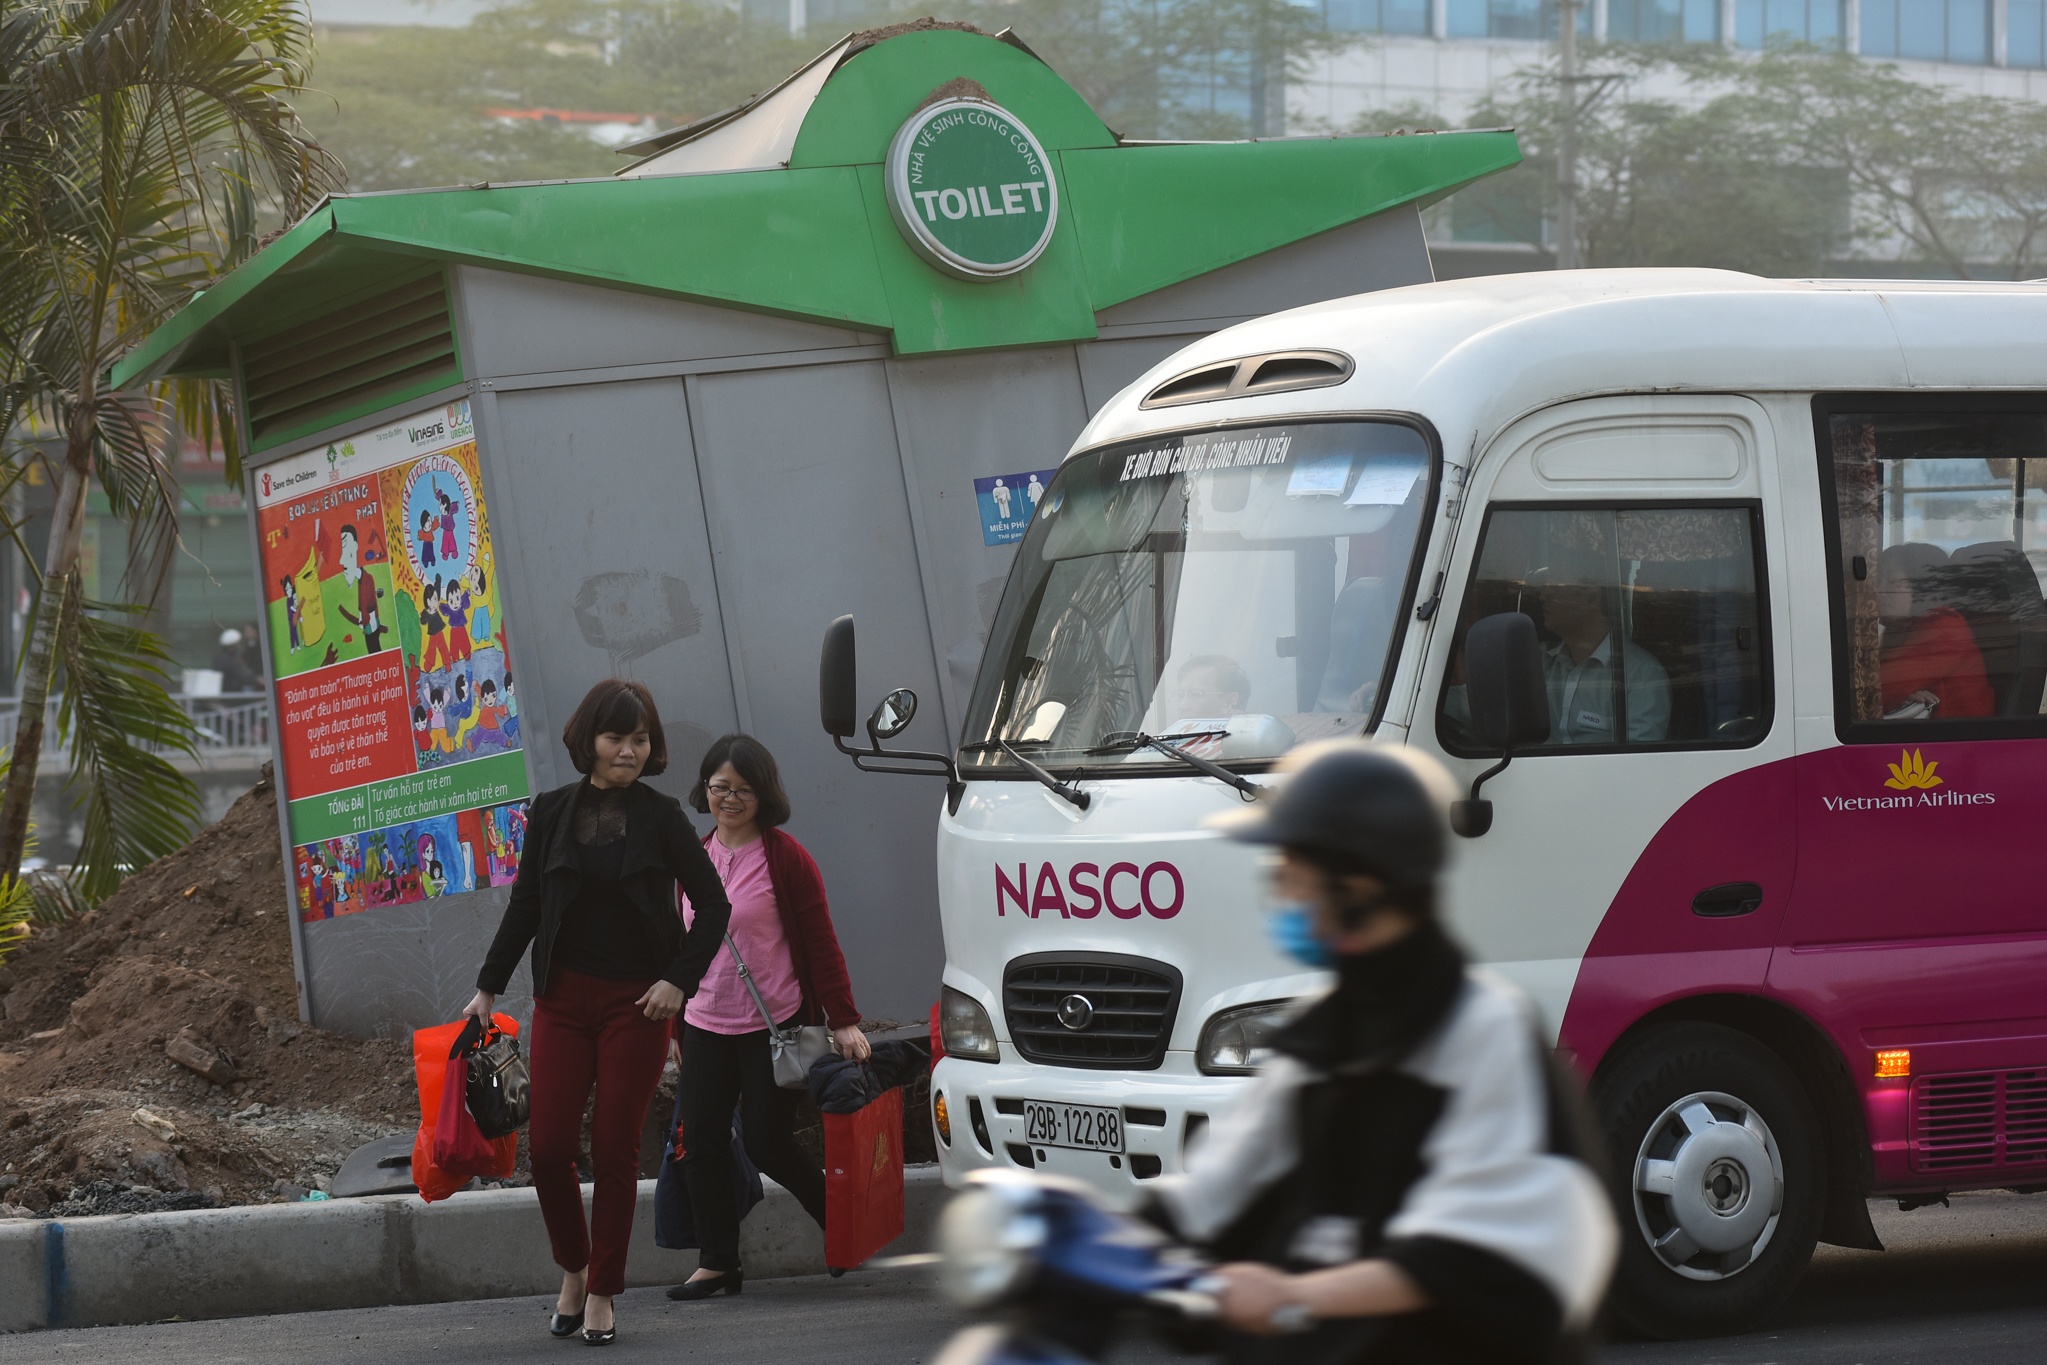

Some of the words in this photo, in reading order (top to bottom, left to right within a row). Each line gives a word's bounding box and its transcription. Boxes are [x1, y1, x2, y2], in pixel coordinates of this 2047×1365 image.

[918, 128, 936, 148] VỆ
[932, 112, 964, 134] SINH
[968, 110, 1008, 136] CÔNG
[911, 151, 926, 185] NHÀ
[1010, 134, 1041, 176] CỘNG
[914, 181, 1046, 222] TOILET
[450, 424, 473, 440] URENCO
[1119, 455, 1134, 481] XE
[1131, 449, 1153, 480] ĐƯA
[1150, 443, 1174, 475] ĐÓN
[1169, 440, 1193, 474] CÁN
[1206, 437, 1236, 470] CÔNG
[1233, 433, 1268, 467] NHÂN
[1263, 431, 1292, 465] VIÊN
[272, 480, 285, 491] Save
[285, 477, 294, 487] the
[295, 470, 317, 484] Children
[309, 686, 319, 699] an
[373, 667, 387, 682] cho
[389, 662, 400, 678] roi
[286, 707, 300, 725] cho
[317, 701, 331, 717] đều
[332, 698, 340, 713] là
[341, 693, 360, 711] hành
[362, 691, 369, 706] vi
[372, 688, 379, 704] vi
[380, 685, 403, 705] phạm
[307, 722, 330, 742] quyền
[331, 718, 351, 734] được
[351, 714, 365, 729] tôn
[365, 710, 387, 727] trọng
[309, 744, 319, 759] và
[320, 740, 335, 757] bảo
[336, 738, 345, 754] vệ
[346, 735, 355, 750] về
[356, 732, 374, 749] thân
[330, 758, 344, 775] của
[345, 754, 356, 771] trẻ
[357, 755, 372, 768] em.
[351, 793, 364, 811] ĐÀI
[372, 788, 382, 803] Tư
[383, 783, 398, 800] vấn
[400, 778, 411, 797] hỗ
[412, 780, 424, 795] trợ
[427, 773, 438, 791] trẻ
[439, 775, 452, 788] em
[1822, 795, 1913, 811] Vietnam
[1917, 789, 1996, 808] Airlines
[374, 806, 385, 823] Tố
[386, 804, 402, 825] giác
[403, 801, 417, 817] các
[418, 796, 438, 814] hành
[439, 794, 447, 809] vi
[448, 791, 465, 807] xâm
[467, 787, 480, 805] hại
[481, 782, 493, 800] trẻ
[494, 784, 508, 797] em
[352, 815, 366, 829] 111
[995, 861, 1185, 920] NASCO
[1026, 1104, 1119, 1148] 29B-122.88
